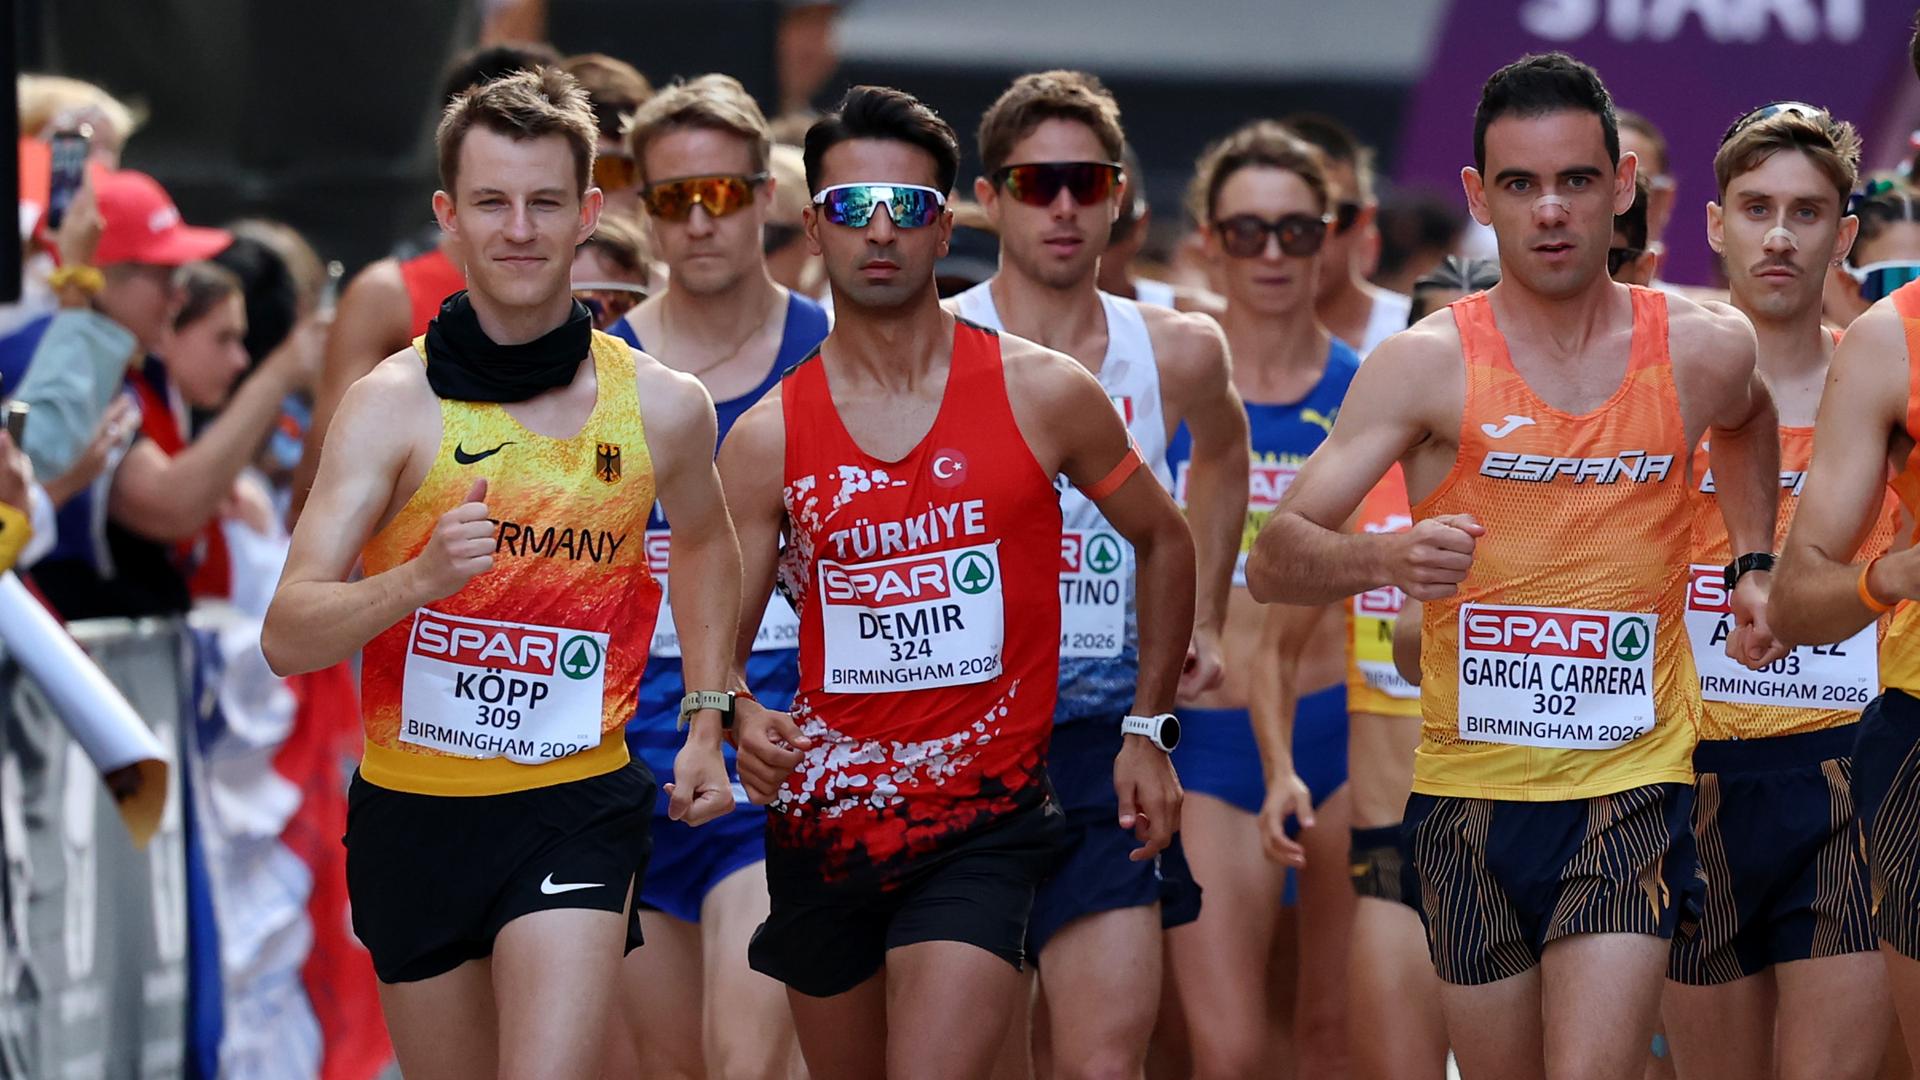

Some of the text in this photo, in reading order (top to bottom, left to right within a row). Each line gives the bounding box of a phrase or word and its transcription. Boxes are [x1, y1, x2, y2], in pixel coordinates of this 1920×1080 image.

[1479, 450, 1674, 484] ESPAÑA
[487, 519, 626, 564] RMANY
[829, 499, 985, 558] TÜRKİYE
[826, 564, 946, 602] SPAR
[859, 604, 965, 641] DEMIR
[1072, 633, 1115, 649] 2026
[1468, 615, 1603, 652] SPAR
[417, 622, 554, 669] SPAR
[890, 639, 933, 662] 324
[455, 668, 549, 709] KÖPP
[832, 663, 954, 685] BIRMINGHAM
[1463, 654, 1646, 695] GARCÍA CARRERA
[1700, 675, 1868, 703] IRMINGHAM 2026
[475, 707, 521, 730] 309
[1533, 693, 1576, 716] 302
[408, 720, 534, 757] BIRMINGHAM
[1467, 717, 1594, 741] BIRMINGHAM
